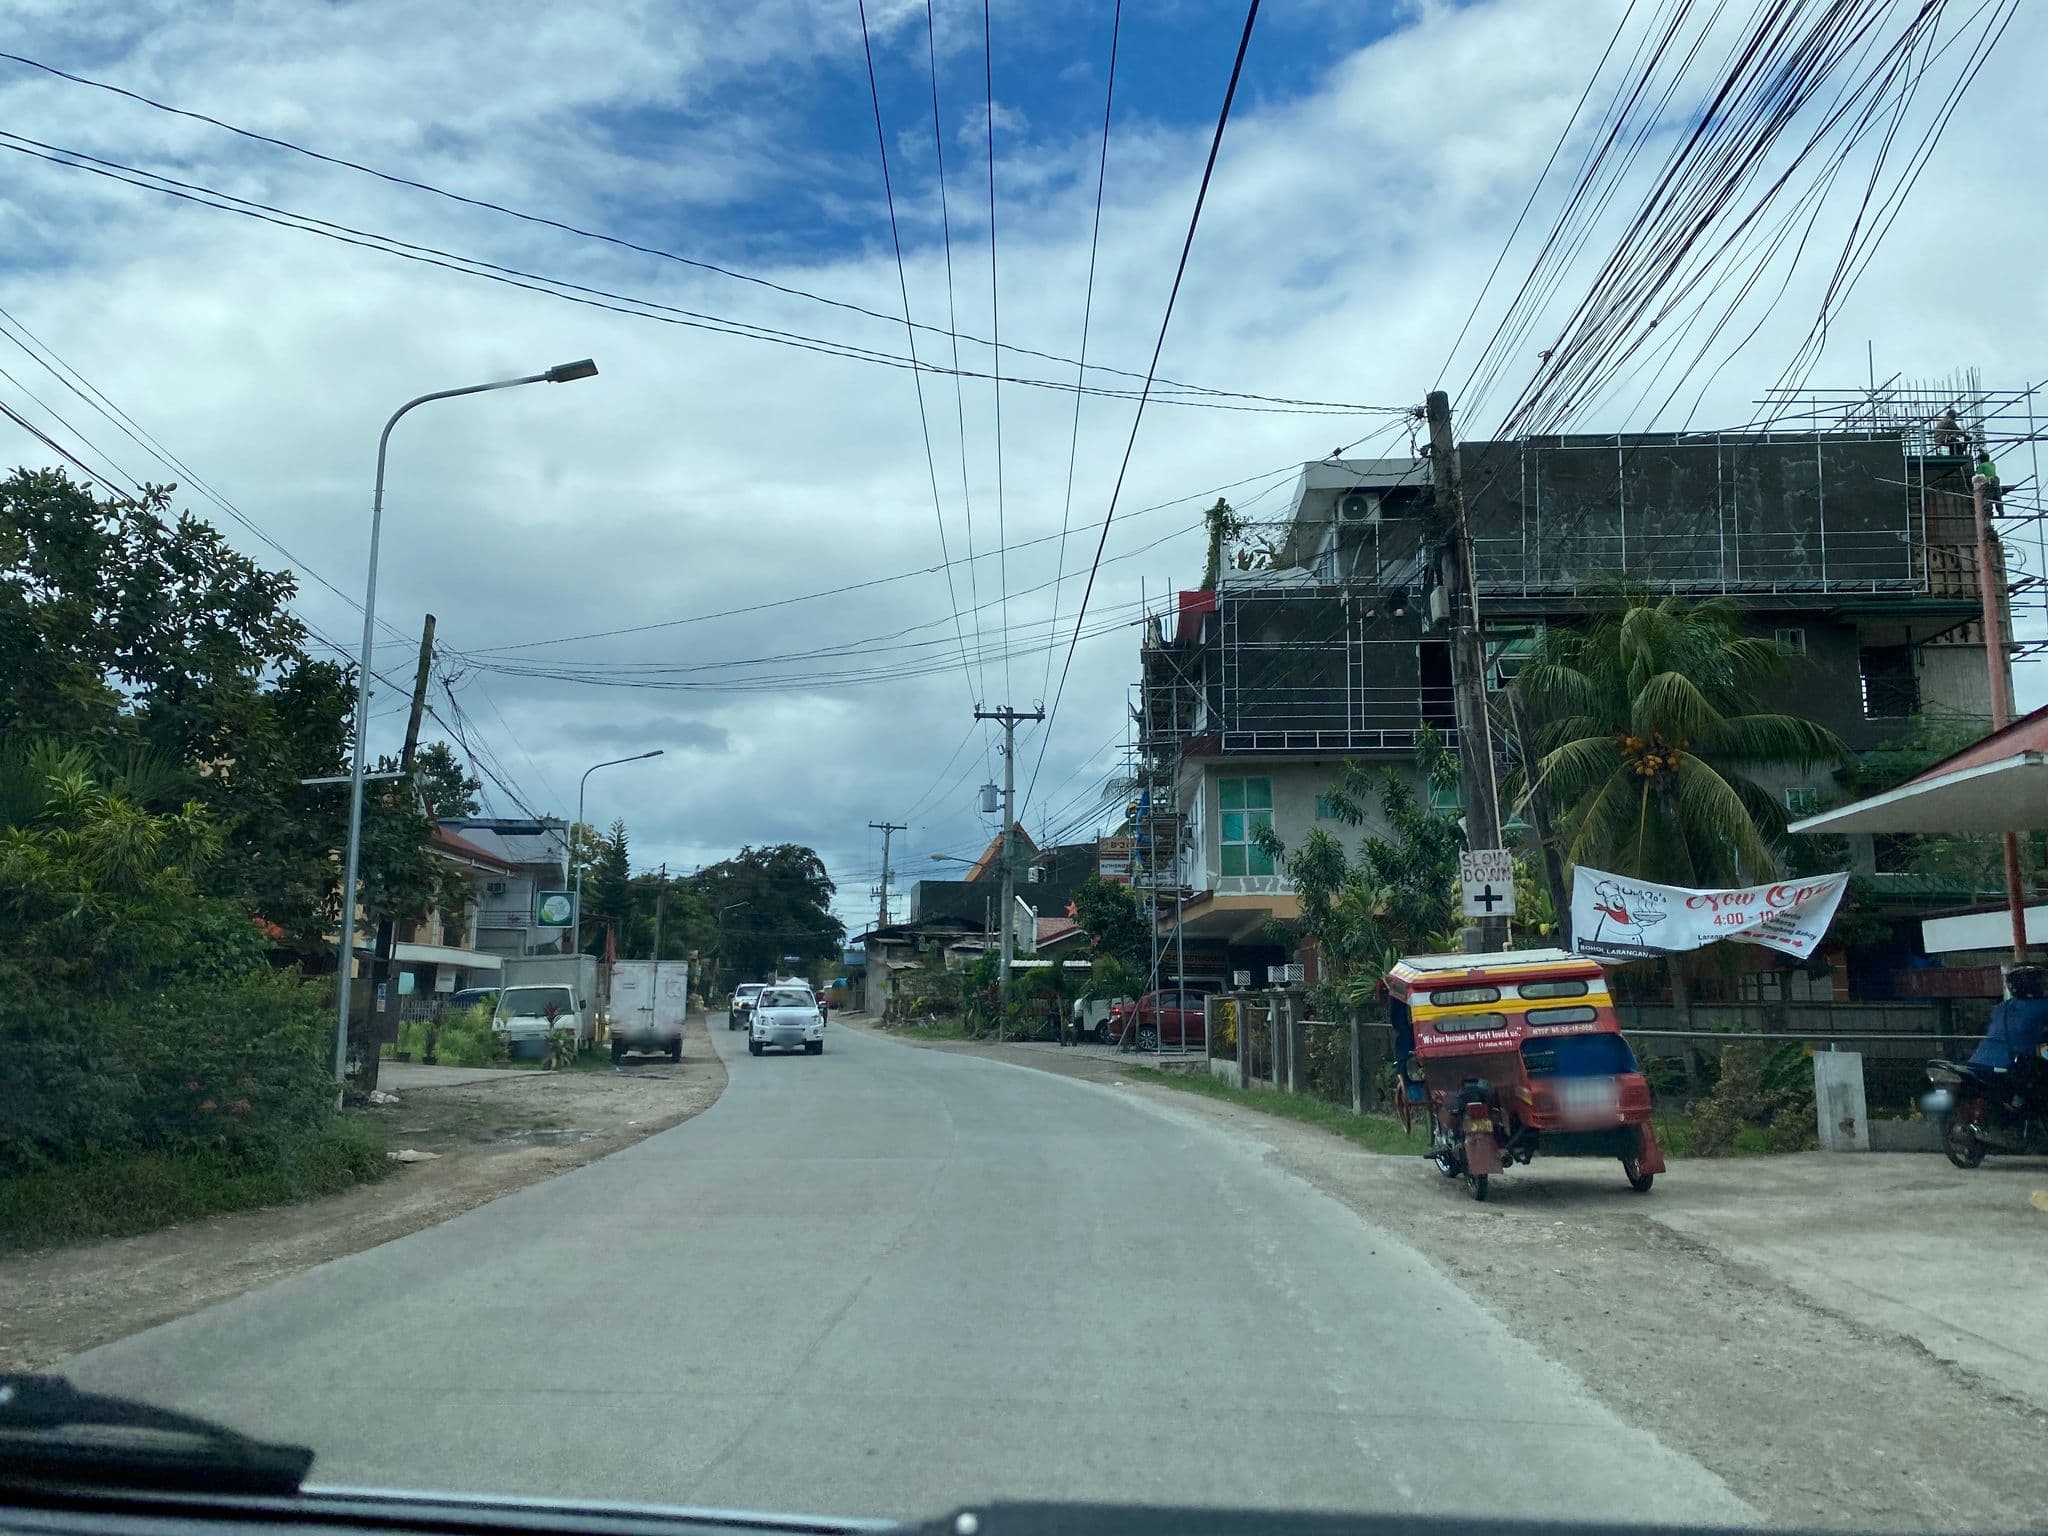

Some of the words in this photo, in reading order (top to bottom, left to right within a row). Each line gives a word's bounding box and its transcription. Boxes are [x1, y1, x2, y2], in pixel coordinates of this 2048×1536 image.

[1461, 852, 1509, 866] SLOW
[1463, 867, 1511, 882] DOWN
[1686, 892, 1755, 911] Now
[1714, 912, 1744, 926] 4:00
[1580, 944, 1606, 954] BOHOL
[1433, 1035, 1445, 1043] love
[1446, 1033, 1467, 1042] because
[1467, 1032, 1475, 1040] he
[1491, 1028, 1509, 1039] loved
